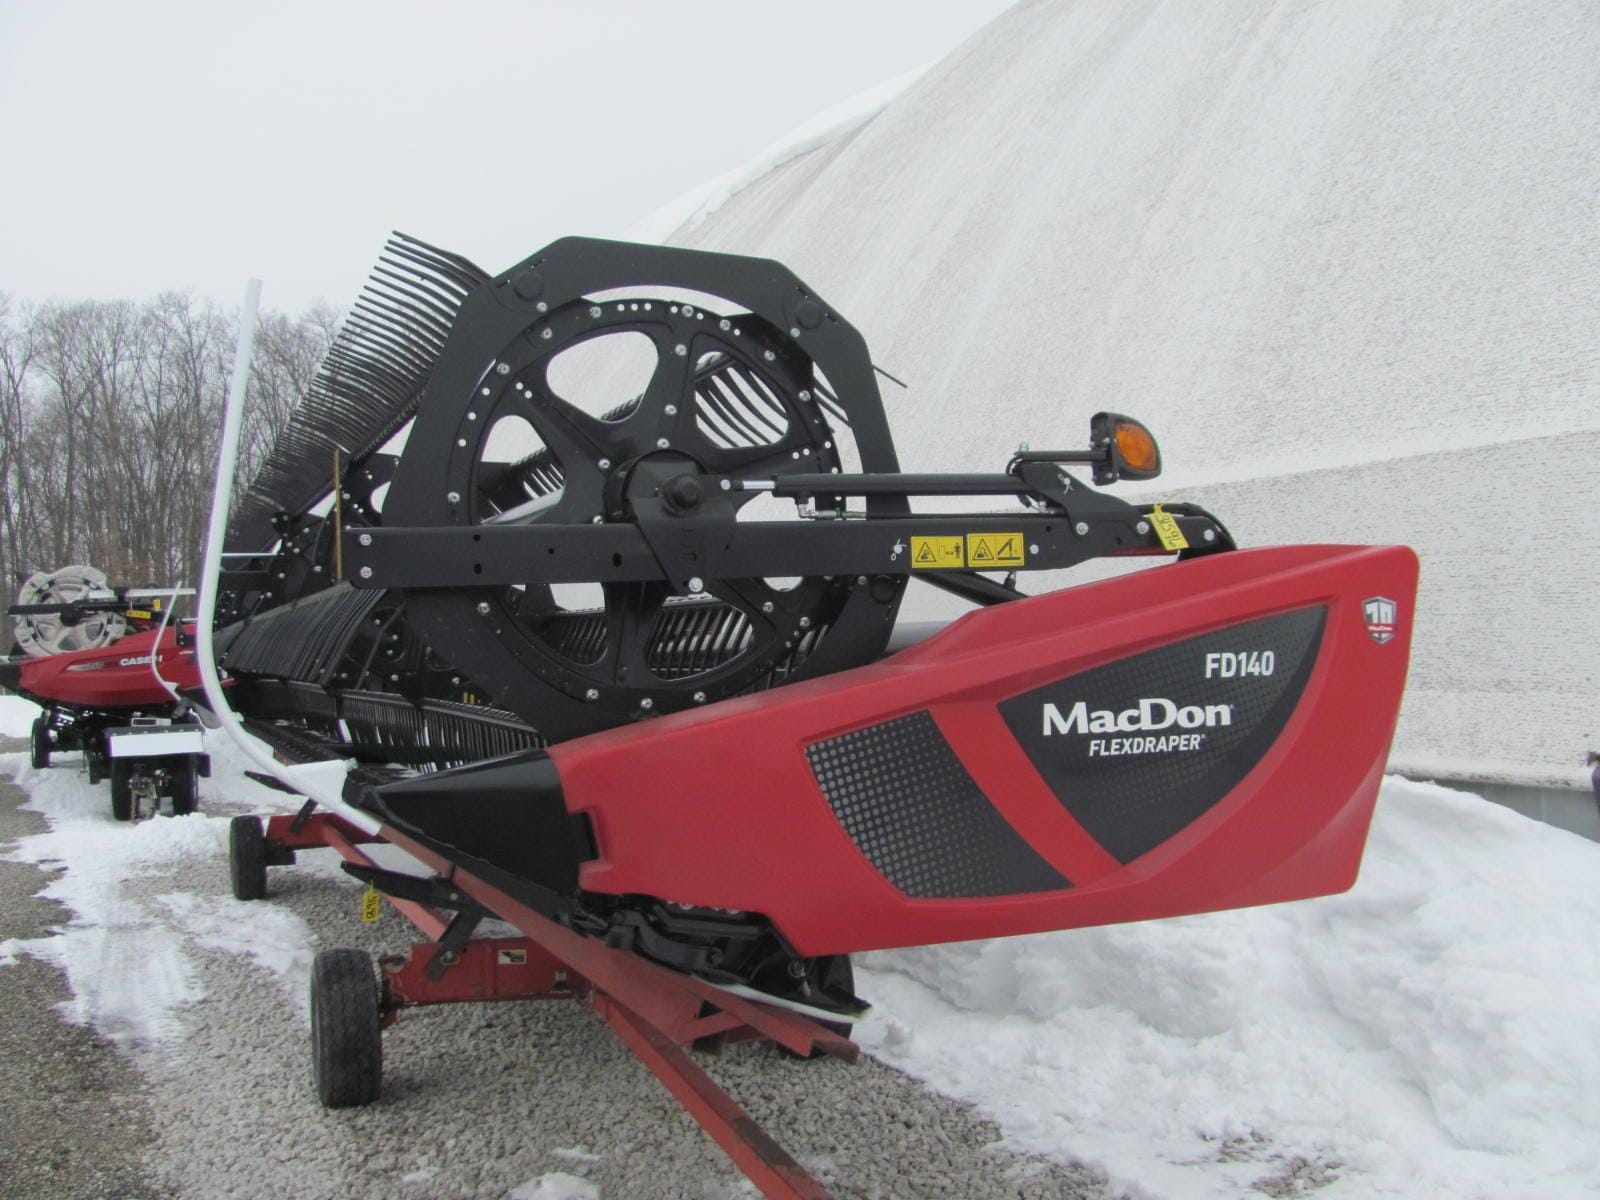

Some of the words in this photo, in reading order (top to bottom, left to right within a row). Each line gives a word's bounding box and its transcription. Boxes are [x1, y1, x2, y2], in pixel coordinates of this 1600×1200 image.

[120, 656, 152, 666] CASE
[1205, 650, 1275, 678] FD140
[1043, 698, 1232, 736] MacDon
[1089, 734, 1203, 757] FLEXDRAPER
